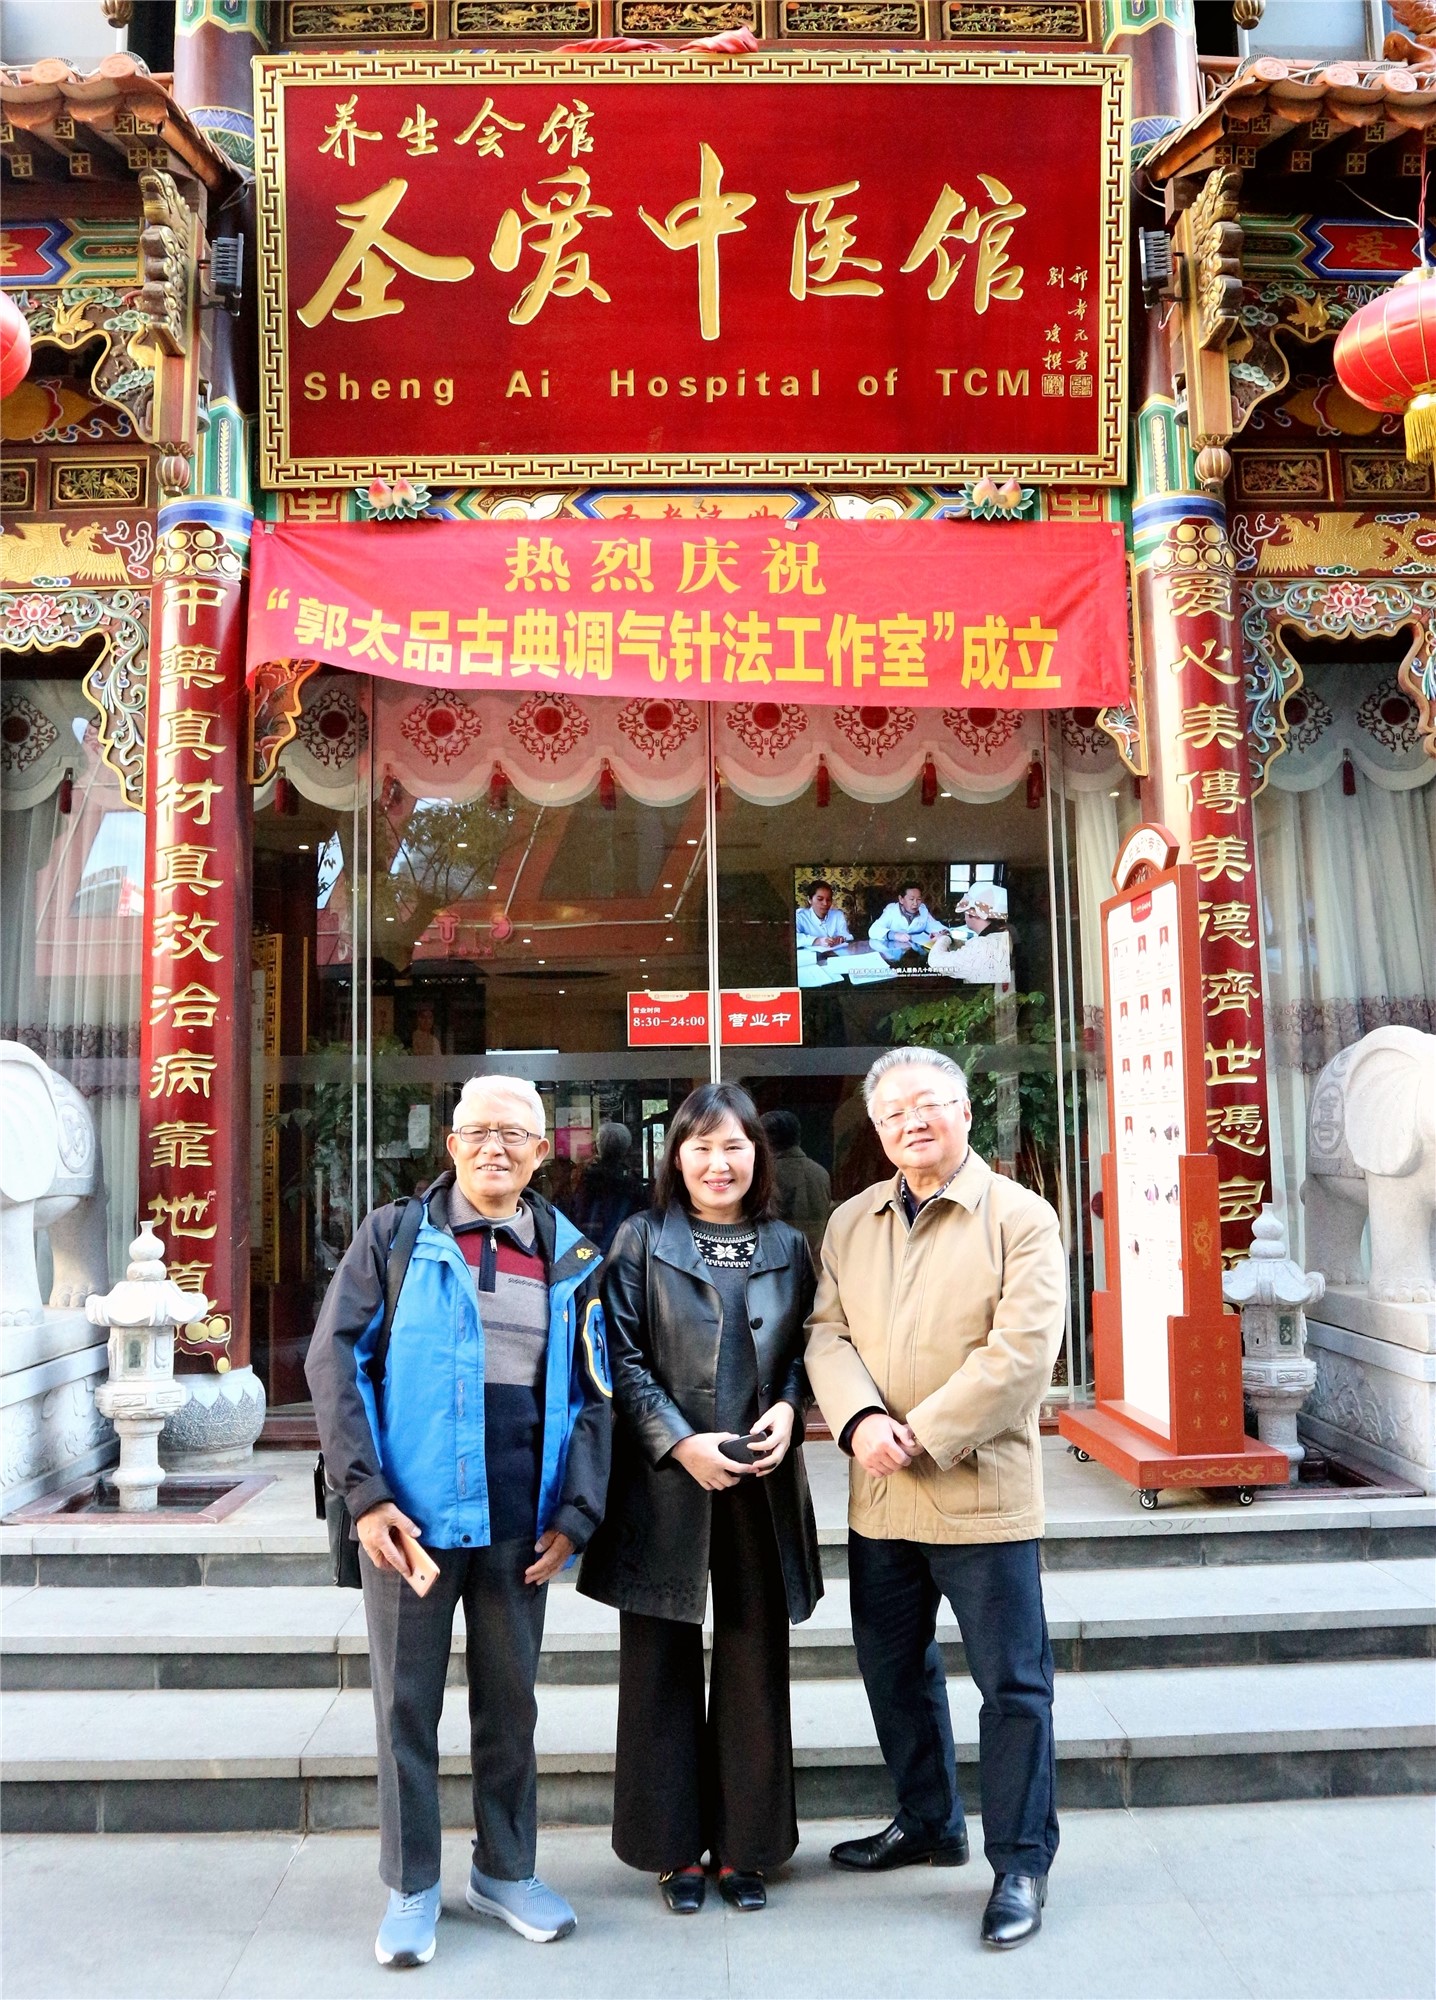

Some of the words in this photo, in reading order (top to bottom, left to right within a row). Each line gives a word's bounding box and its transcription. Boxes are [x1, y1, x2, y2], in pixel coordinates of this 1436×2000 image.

[317, 94, 595, 167] 养生会馆
[303, 370, 456, 406] Sheng
[505, 370, 551, 399] Ai
[610, 368, 821, 403] Hospital
[857, 368, 899, 397] of
[935, 368, 1030, 398] TCM
[504, 536, 827, 596] 热烈庆祝
[1166, 574, 1267, 1272] 愛心美傳美德濟世憑良
[632, 1006, 661, 1014] 营业时间
[728, 1013, 791, 1028] 营业中
